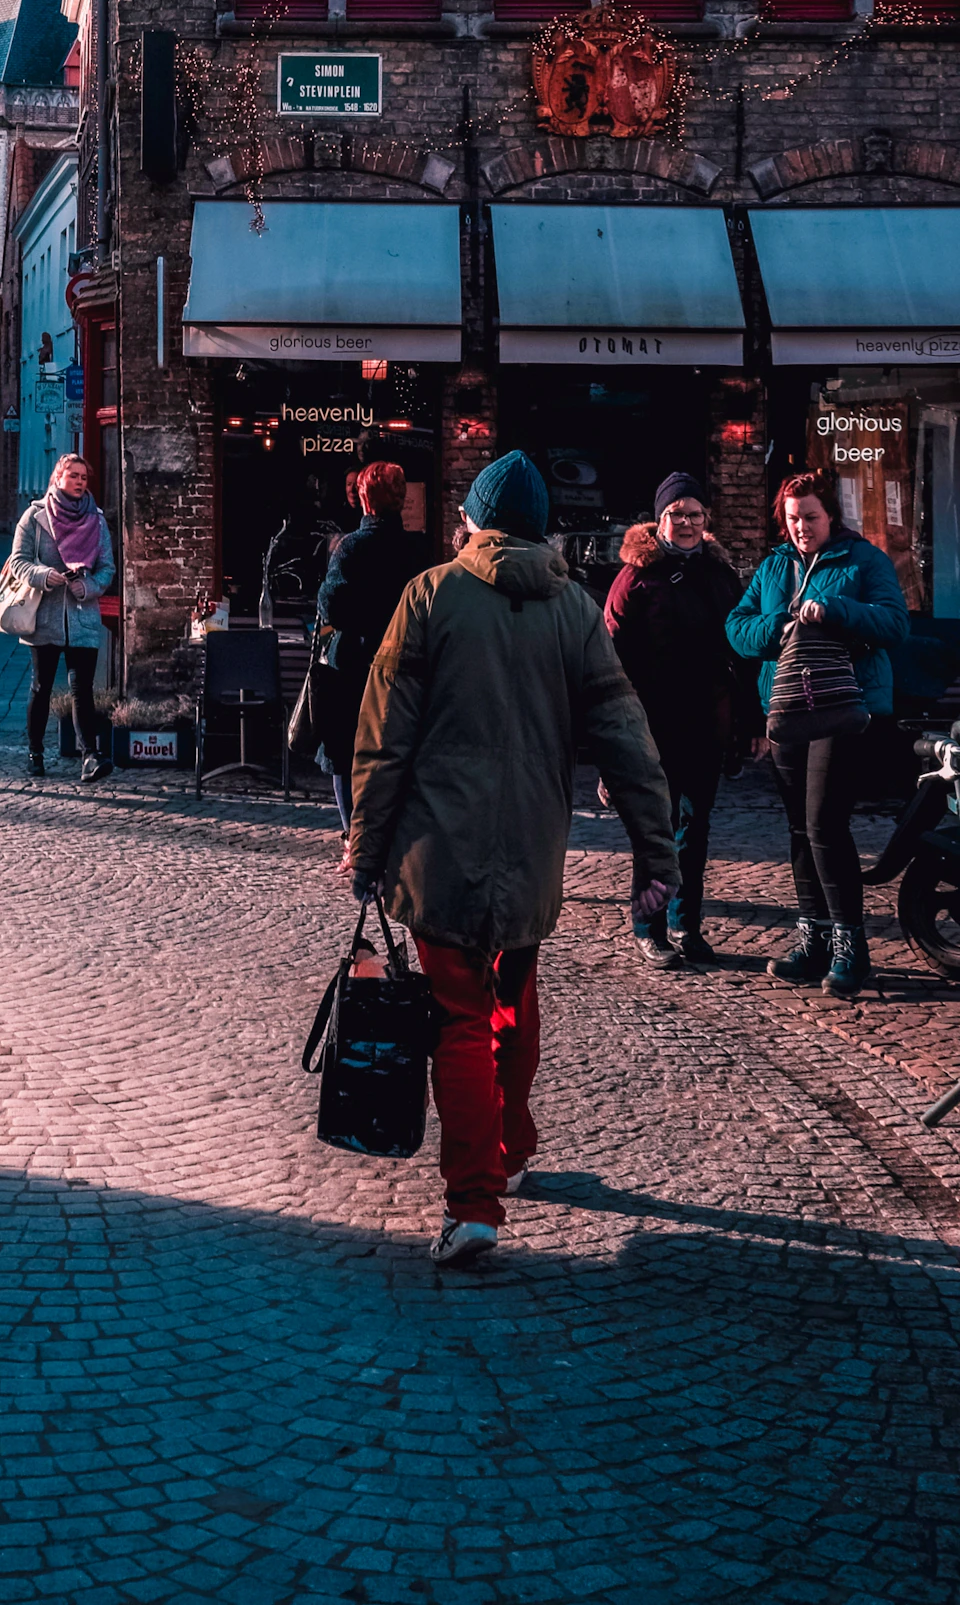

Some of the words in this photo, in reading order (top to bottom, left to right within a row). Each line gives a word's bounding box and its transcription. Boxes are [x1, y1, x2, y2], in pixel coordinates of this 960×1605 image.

[314, 64, 345, 77] SIMON
[299, 84, 361, 98] STEVINPLEIN
[344, 102, 359, 112] 1548
[363, 102, 378, 112] 1620
[270, 334, 332, 352] glorious
[336, 334, 372, 349] beer
[579, 336, 662, 356] OTOMAT
[856, 337, 924, 356] heavenly
[929, 338, 960, 356] pizz
[281, 402, 374, 428] heavenly
[816, 411, 902, 436] glorious
[303, 433, 355, 457] pizza
[834, 442, 885, 462] beer
[133, 740, 174, 756] Duvel
